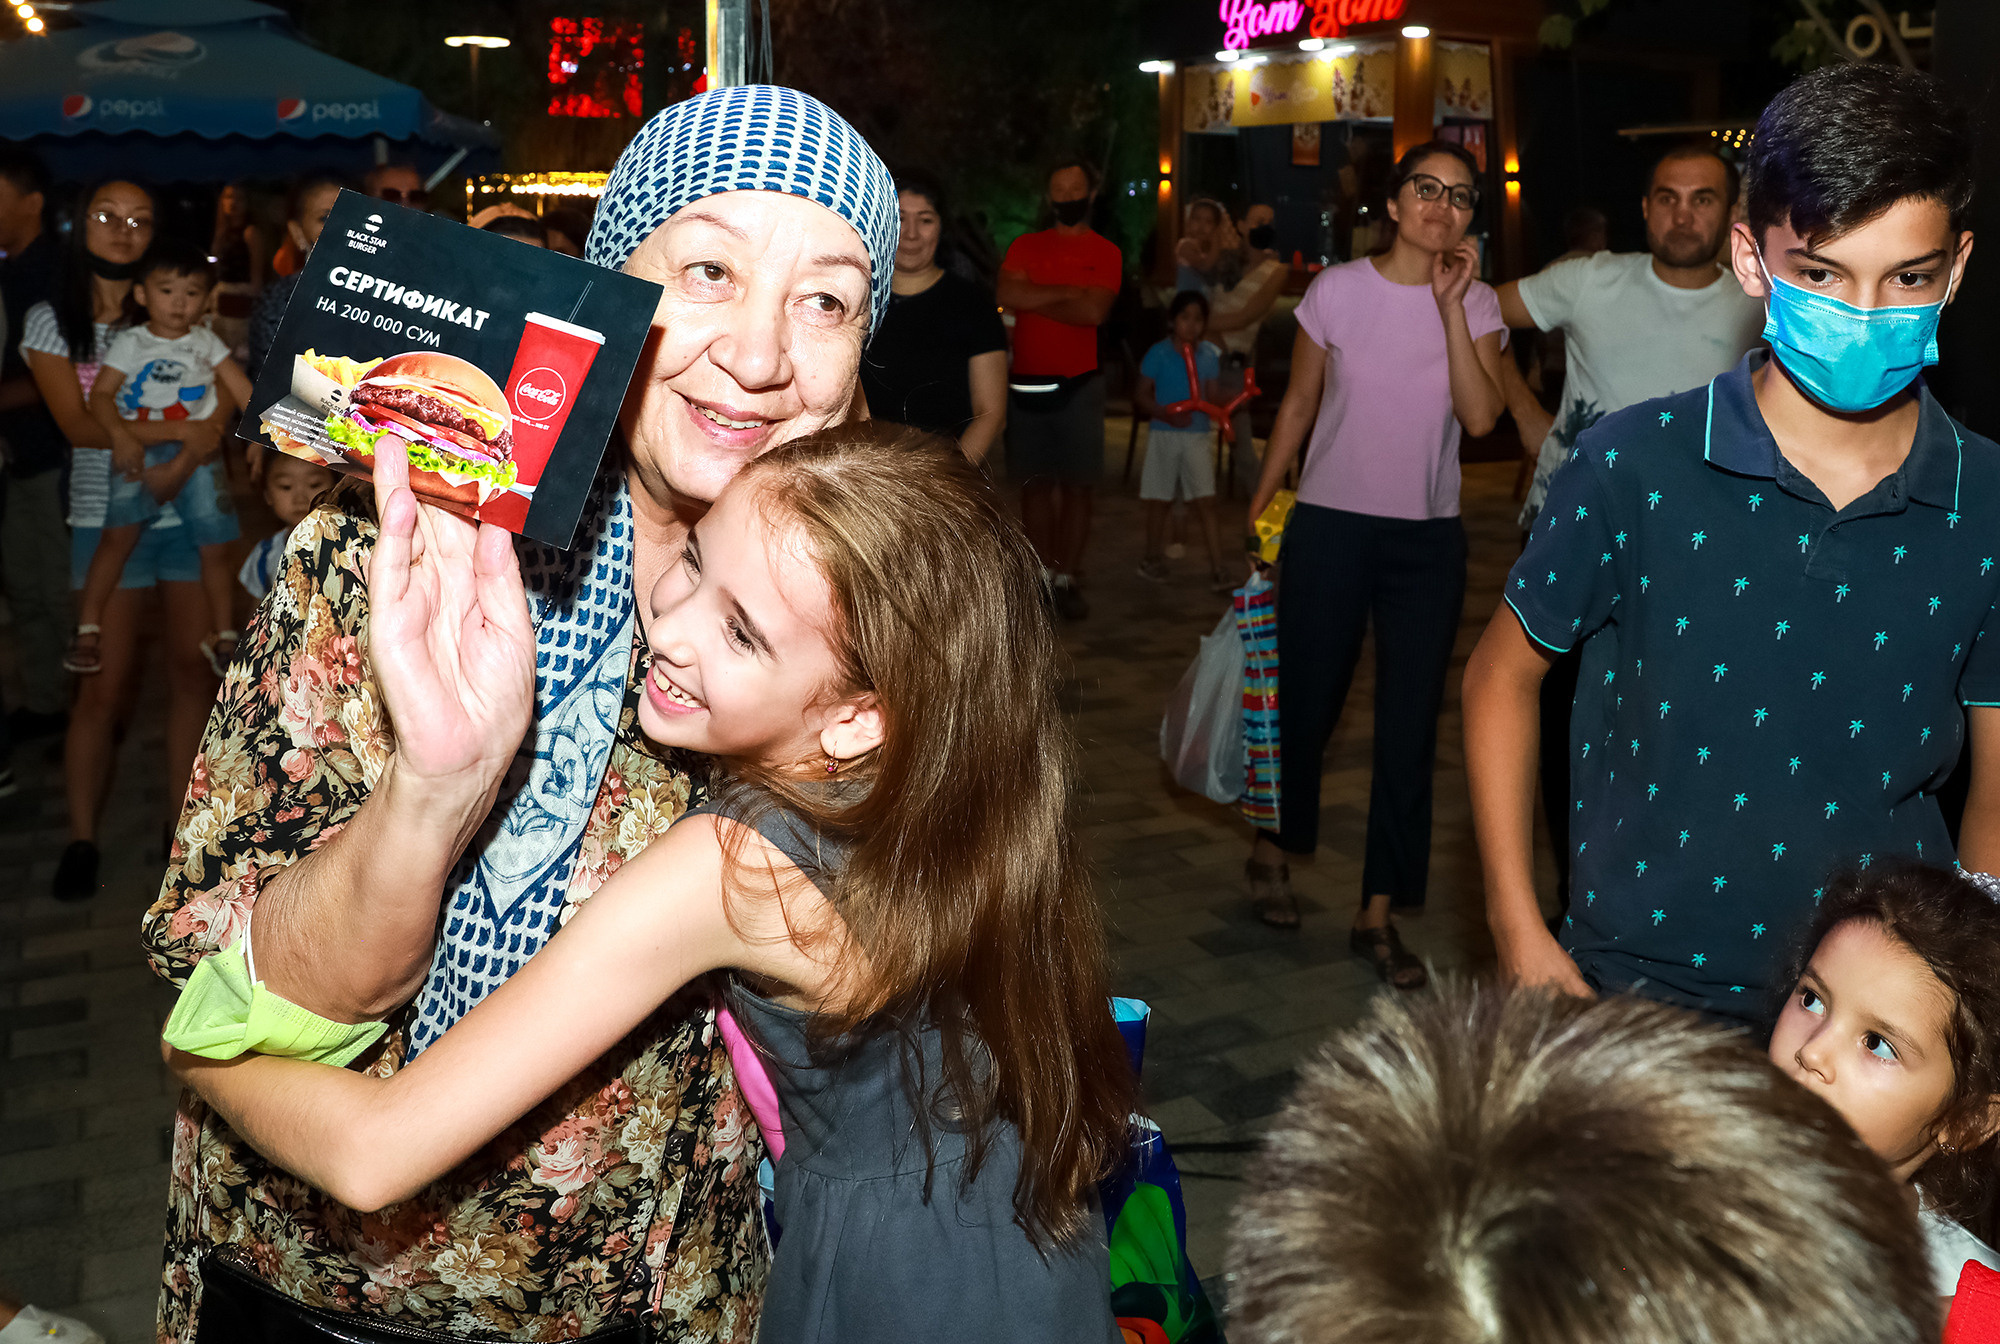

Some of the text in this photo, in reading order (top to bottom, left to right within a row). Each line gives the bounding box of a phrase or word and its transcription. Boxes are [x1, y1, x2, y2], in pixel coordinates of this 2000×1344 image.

[99, 97, 164, 119] pepsi
[311, 99, 380, 123] pepsi
[346, 229, 388, 249] BLACK STAR
[348, 239, 377, 255] BURGER
[329, 266, 491, 332] СЕРТИФИКАТ
[315, 296, 441, 348] НА 200 000 СУМ
